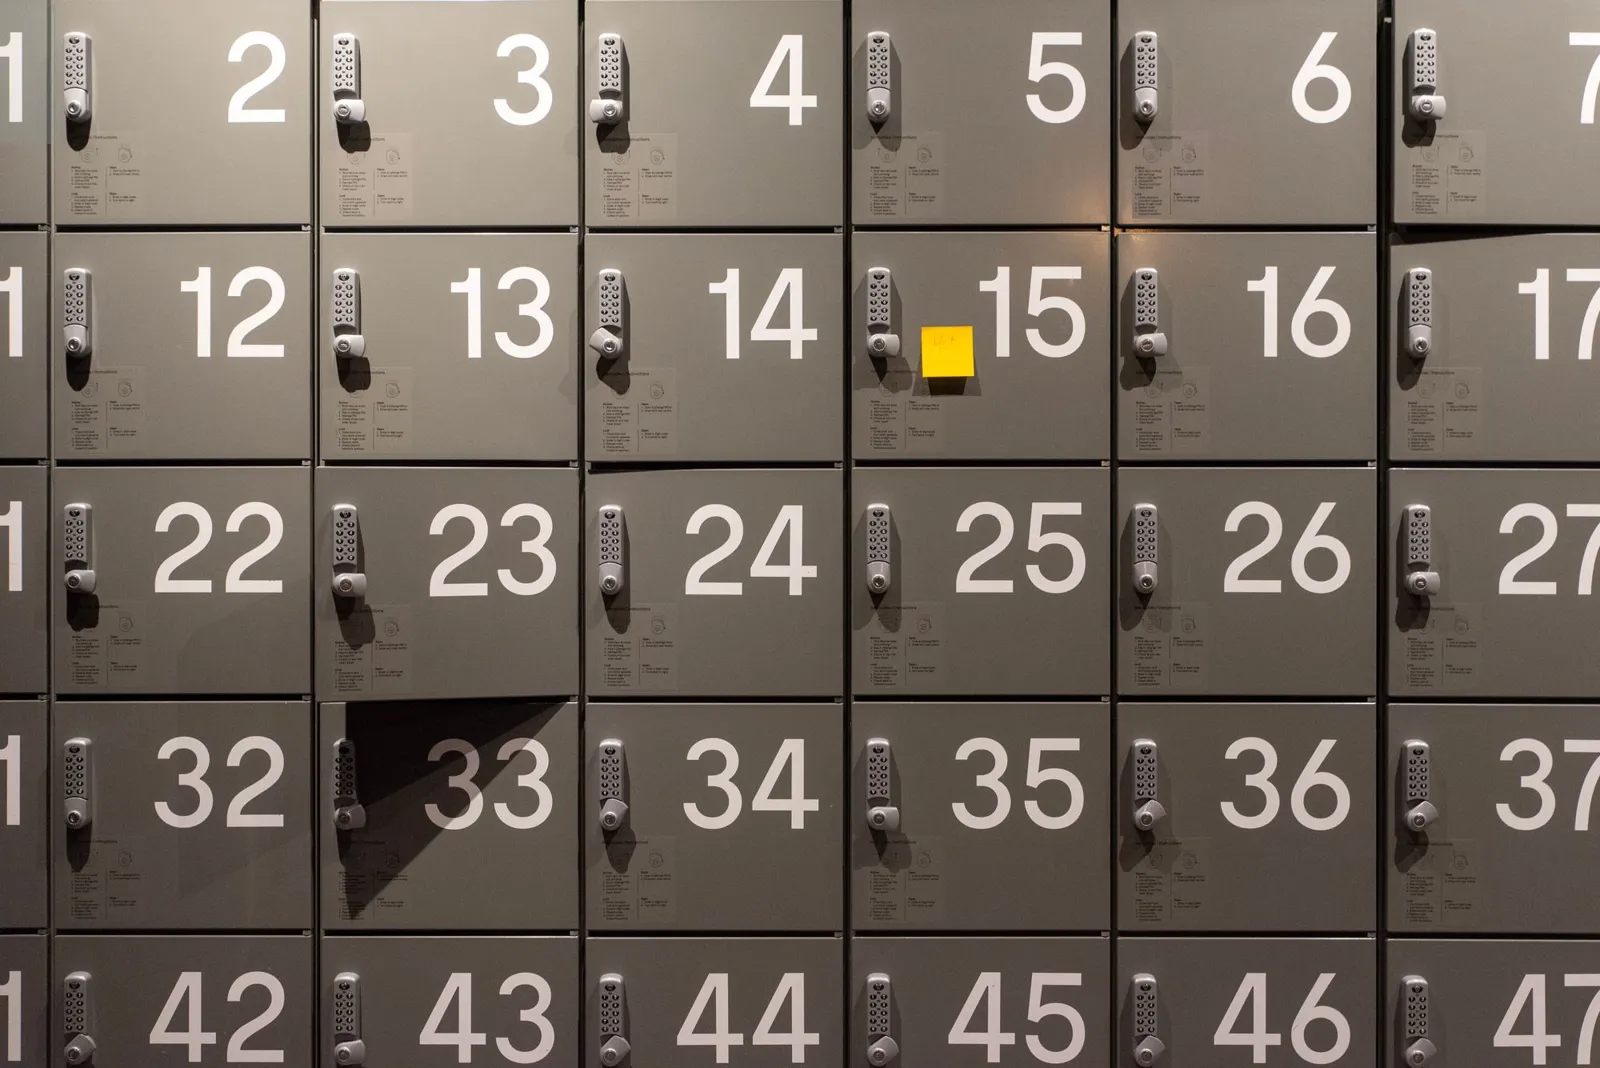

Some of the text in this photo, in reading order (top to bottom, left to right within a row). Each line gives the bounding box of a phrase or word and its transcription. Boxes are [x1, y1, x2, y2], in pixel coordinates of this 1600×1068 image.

[0, 32, 22, 122] 1
[228, 31, 285, 122] 2
[494, 34, 552, 125] 3
[750, 35, 817, 125] 4
[1026, 32, 1086, 123] 5
[1292, 32, 1351, 123] 6
[181, 266, 285, 357] 12
[451, 267, 553, 358] 13
[709, 268, 817, 359] 14
[980, 266, 1085, 358] 15
[1247, 266, 1351, 358] 16
[155, 502, 283, 593] 22
[429, 503, 556, 597] 23
[685, 504, 817, 595] 24
[956, 502, 1086, 593] 25
[1224, 501, 1351, 593] 26
[154, 736, 284, 828] 32
[425, 738, 553, 830] 33
[683, 738, 819, 829] 34
[952, 737, 1084, 829] 35
[1220, 737, 1350, 830] 36
[150, 971, 284, 1062] 42
[420, 972, 554, 1064] 43
[677, 973, 819, 1063] 44
[948, 972, 1085, 1064] 45
[1214, 973, 1350, 1064] 46
